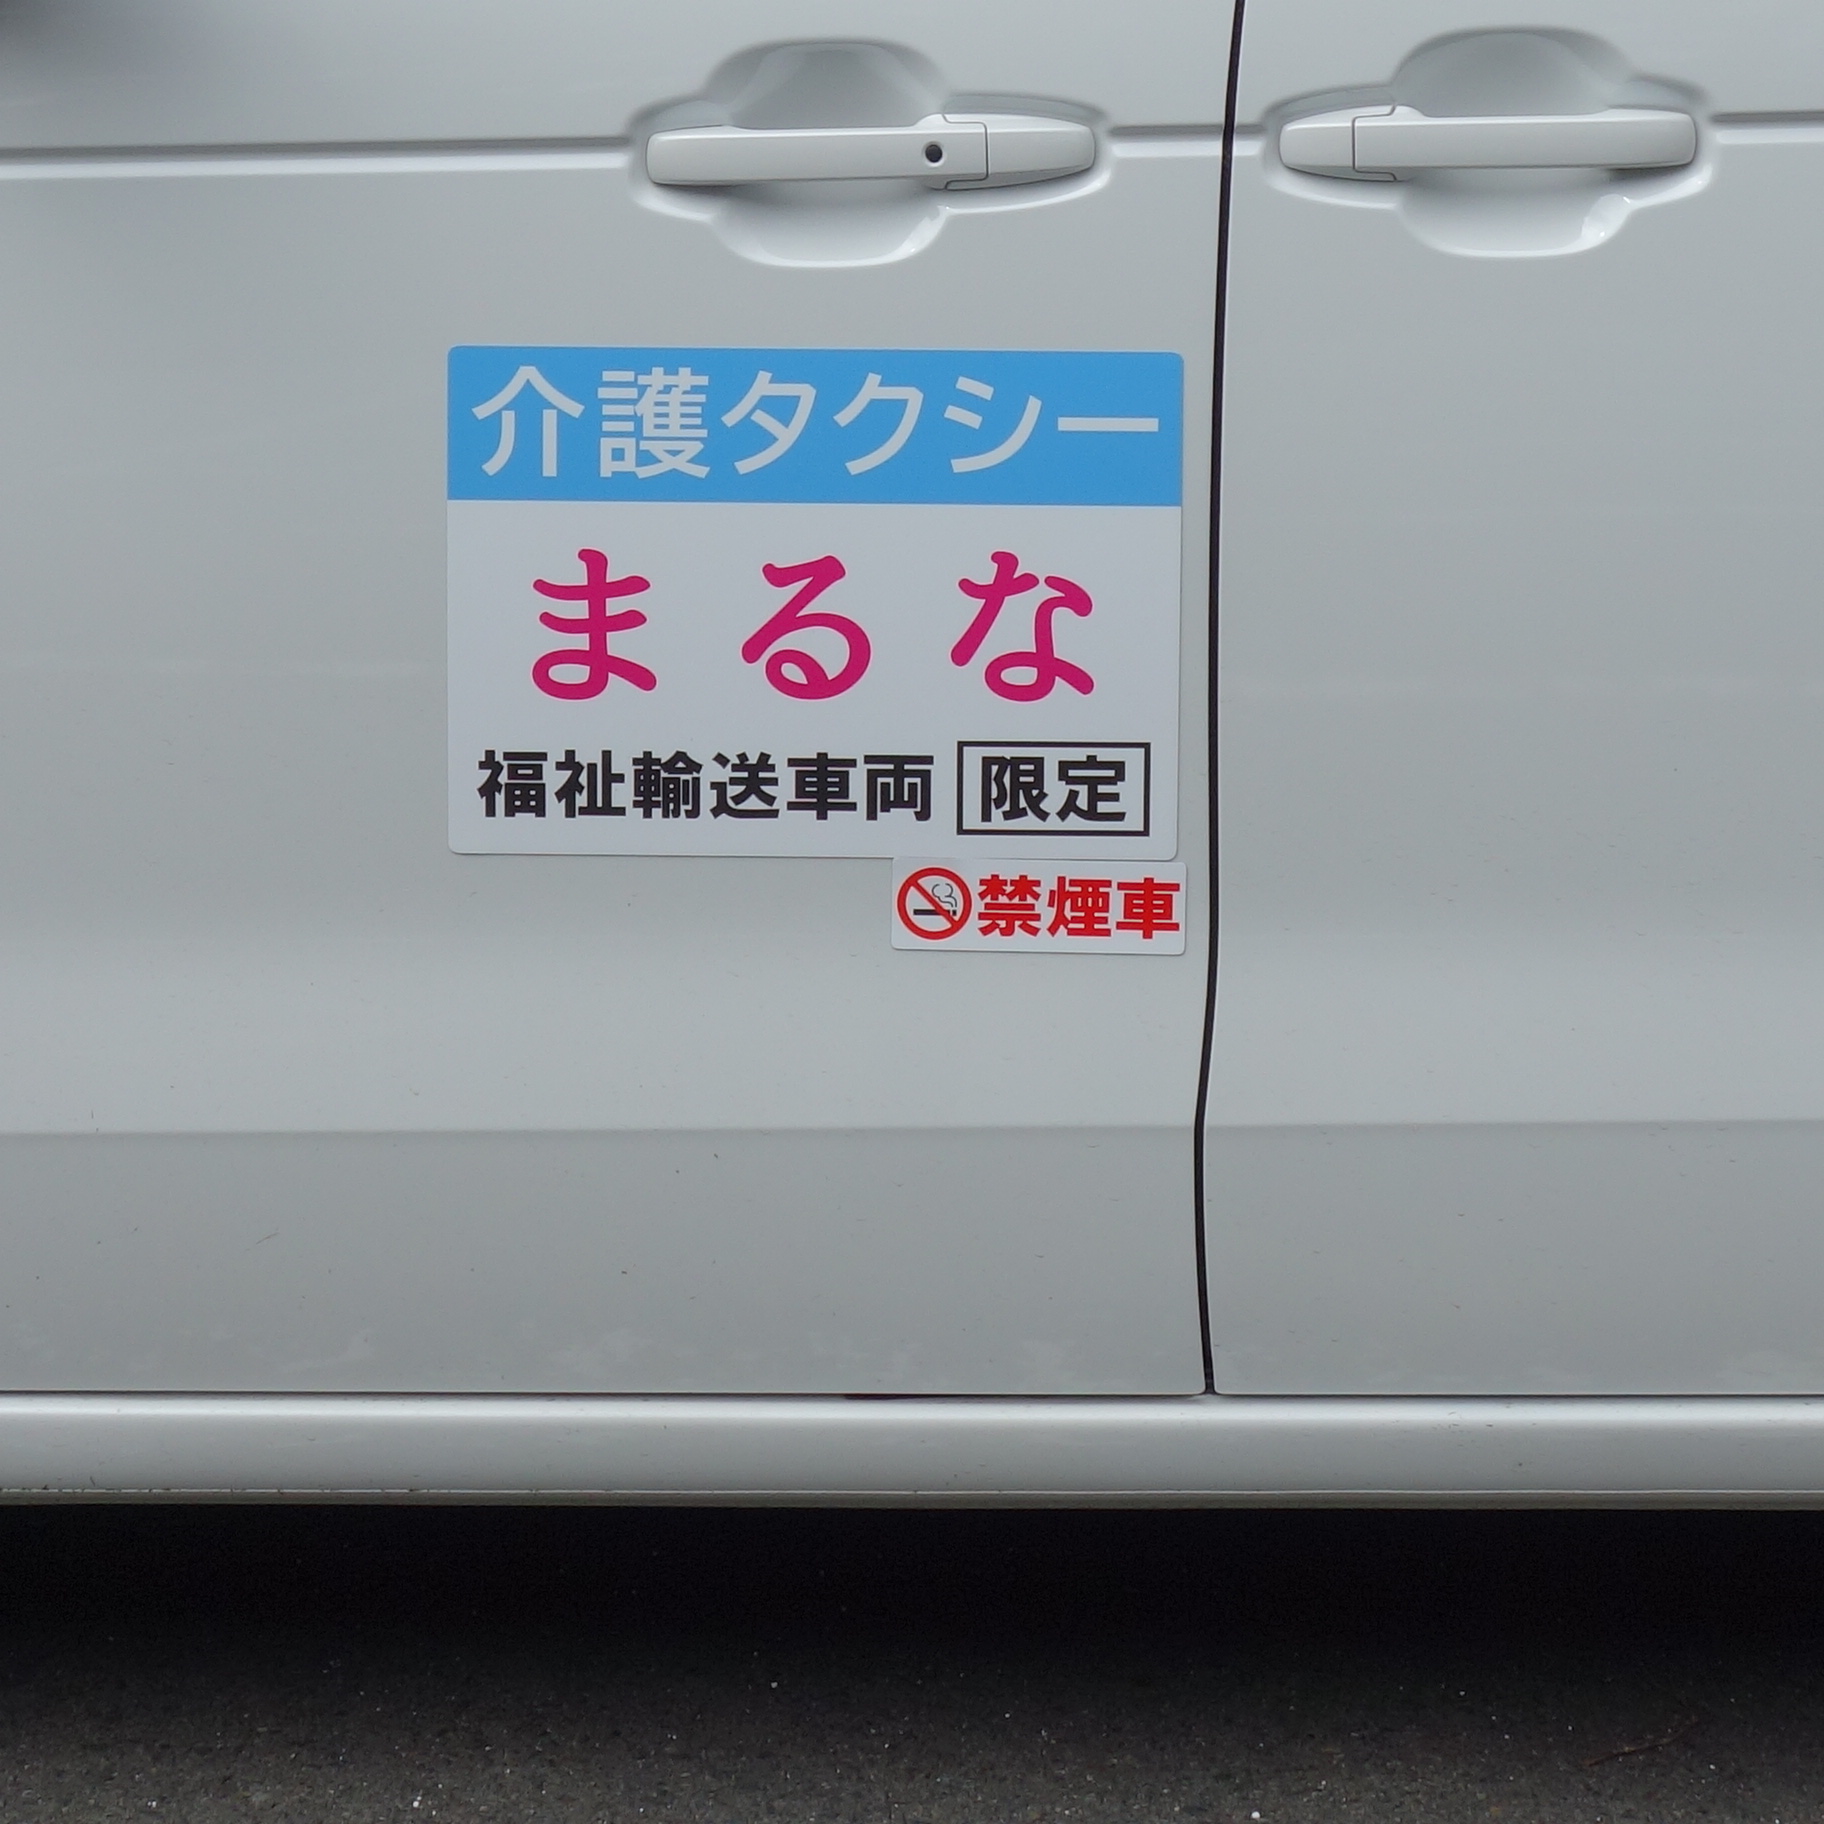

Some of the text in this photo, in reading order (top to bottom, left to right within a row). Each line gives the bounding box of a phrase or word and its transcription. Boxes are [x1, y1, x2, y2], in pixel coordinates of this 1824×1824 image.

[473, 366, 1159, 478] 介護タクシー
[532, 548, 1095, 702] まるな
[477, 749, 1127, 823] 福祉輸送車両 限定
[977, 874, 1181, 940] 禁煙車
